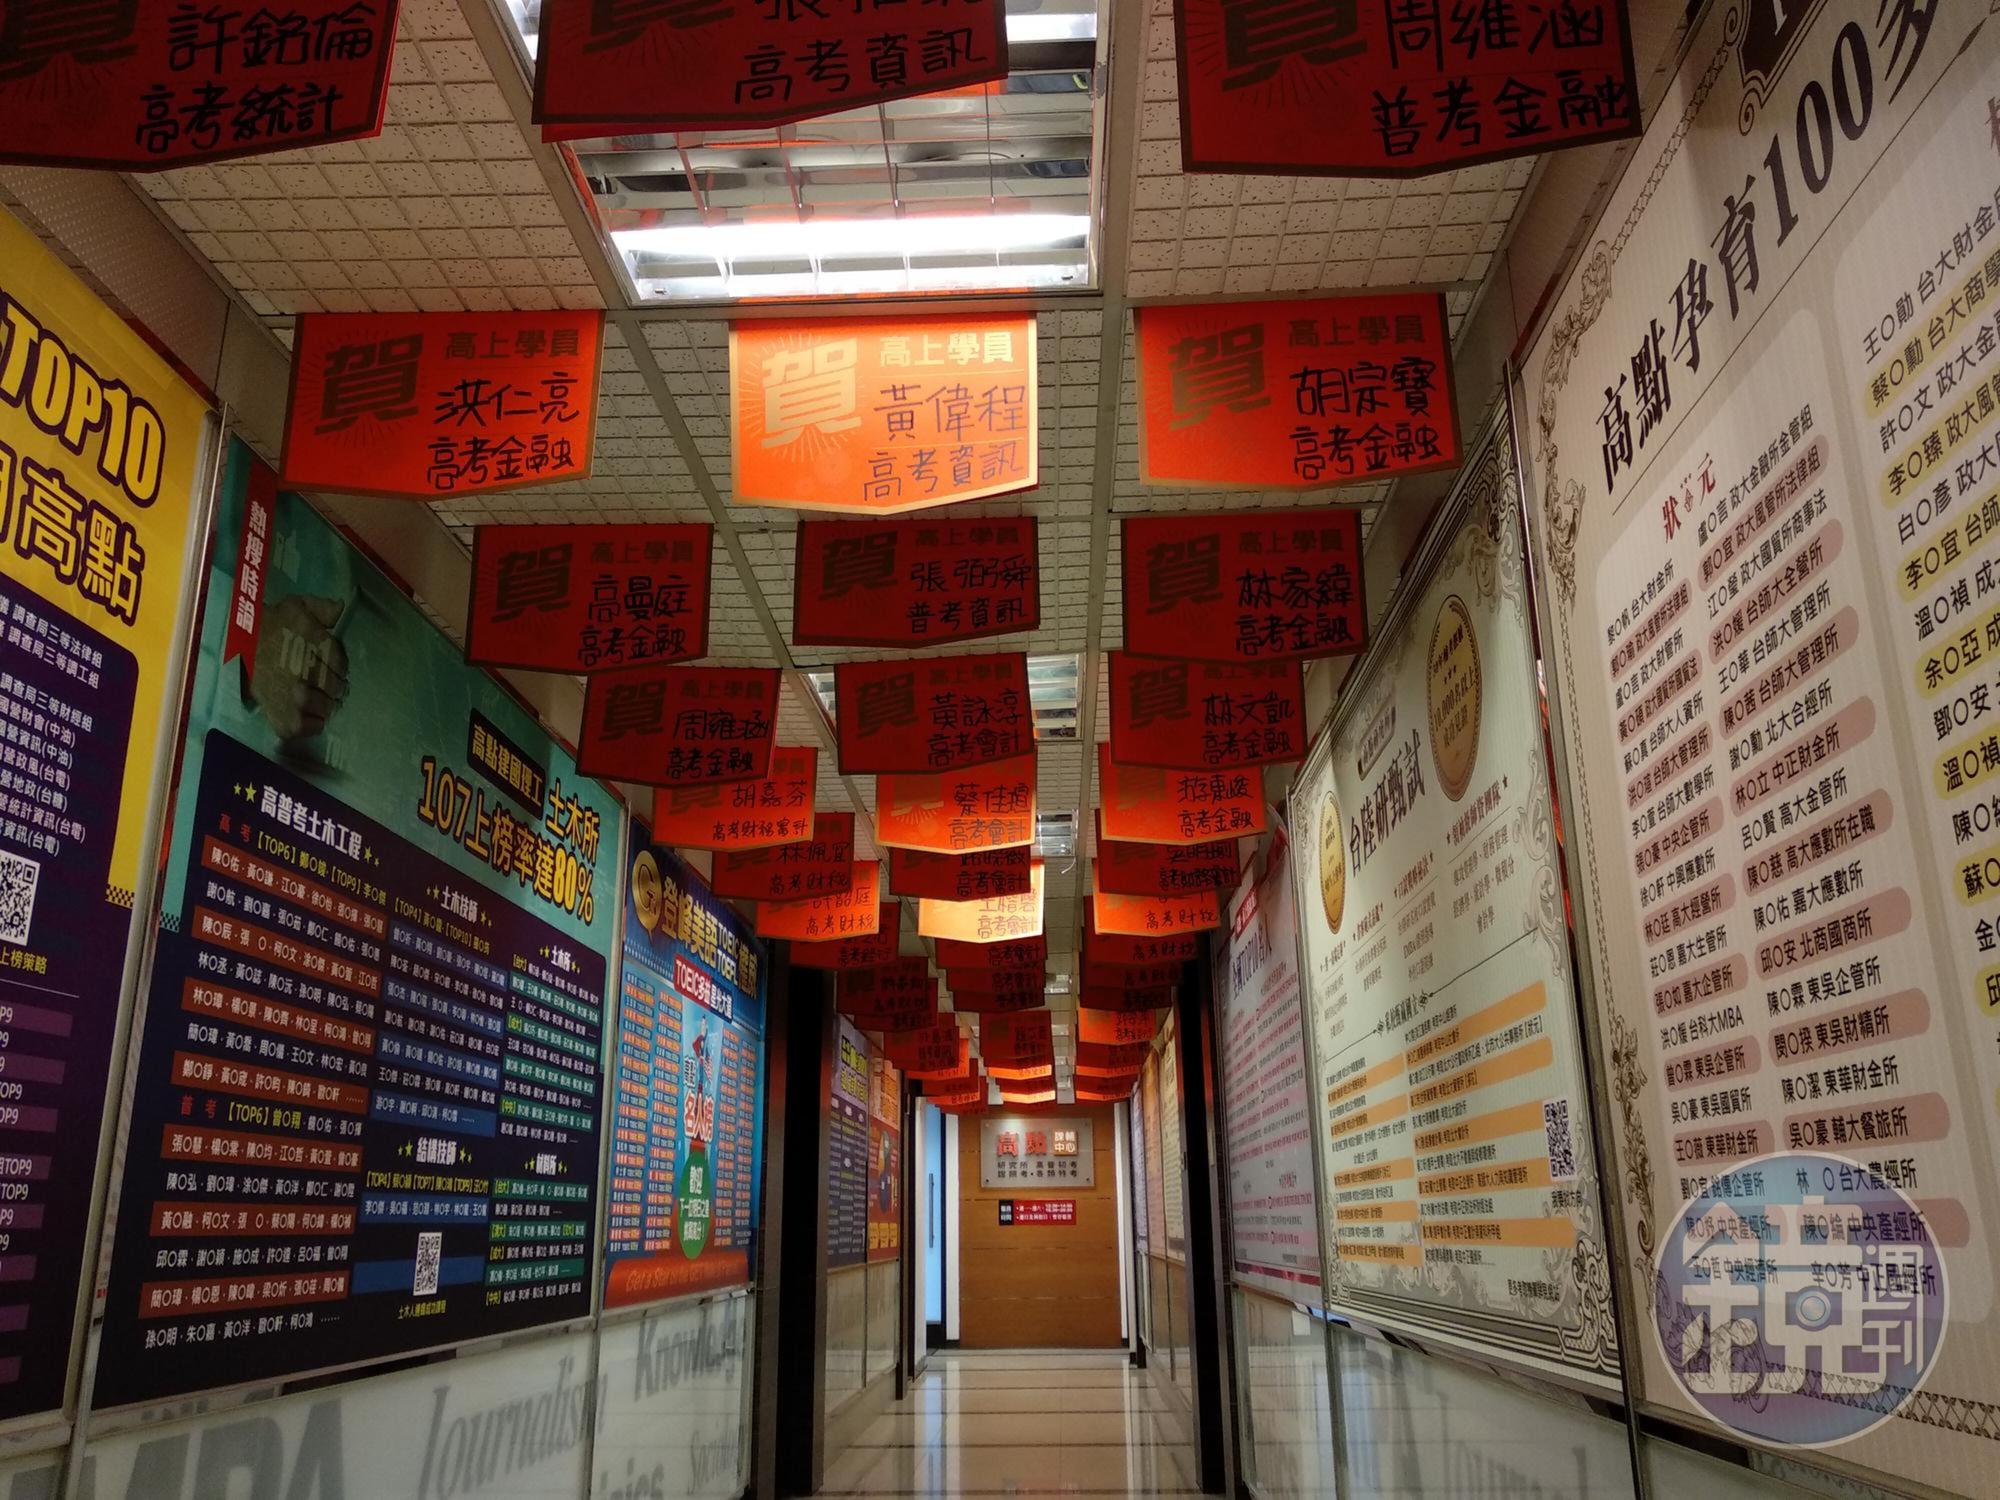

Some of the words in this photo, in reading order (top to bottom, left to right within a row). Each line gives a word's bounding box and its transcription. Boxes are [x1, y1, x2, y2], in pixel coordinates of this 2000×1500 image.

[168, 2, 373, 74] 許銘倫
[735, 27, 988, 104] 高考資訊
[135, 82, 343, 154] 高考統計
[1373, 70, 1629, 156] 普考金融
[445, 329, 579, 360] 高上學員
[880, 331, 1013, 367] 高上學員
[1288, 315, 1424, 347] 高上學員
[314, 334, 424, 434] 賀
[433, 372, 579, 426] 洪仁亮
[761, 338, 862, 448] 賀
[1168, 322, 1272, 431] 賀
[874, 383, 1027, 443] 黃偉程
[427, 435, 575, 490] 高考金融
[864, 440, 1024, 501] 高考資訊
[1288, 422, 1441, 480] 高考金融
[491, 543, 573, 623] 賀
[818, 530, 898, 601] 賀
[1146, 533, 1224, 616] 賀
[906, 597, 1027, 633] 普考資訊
[1235, 613, 1354, 657] 高考金融
[1752, 579, 1831, 665] 台師大管理所
[577, 624, 686, 667] 高考金融
[1757, 623, 1841, 698] 台師大管理所
[667, 747, 753, 779] 高考金融
[926, 728, 1021, 768] 高考會計
[1201, 727, 1294, 765] 高考金融
[1772, 722, 1840, 785] 中正財金所
[260, 785, 363, 860] 高普考土木工程
[545, 778, 600, 865] 土木所
[1177, 807, 1256, 839] 高考金融
[1778, 767, 1848, 826] 高大金管所
[417, 755, 594, 926] 107上榜率達80%
[1785, 804, 1876, 869] 高大應數所在職
[1793, 859, 1864, 915] 嘉大應數所
[1800, 907, 1873, 960] 北商國商所
[1806, 955, 1881, 1005] 東吳企管所
[1689, 1005, 1744, 1043] 台科大MBA
[1823, 1055, 1899, 1097] 東華財金所
